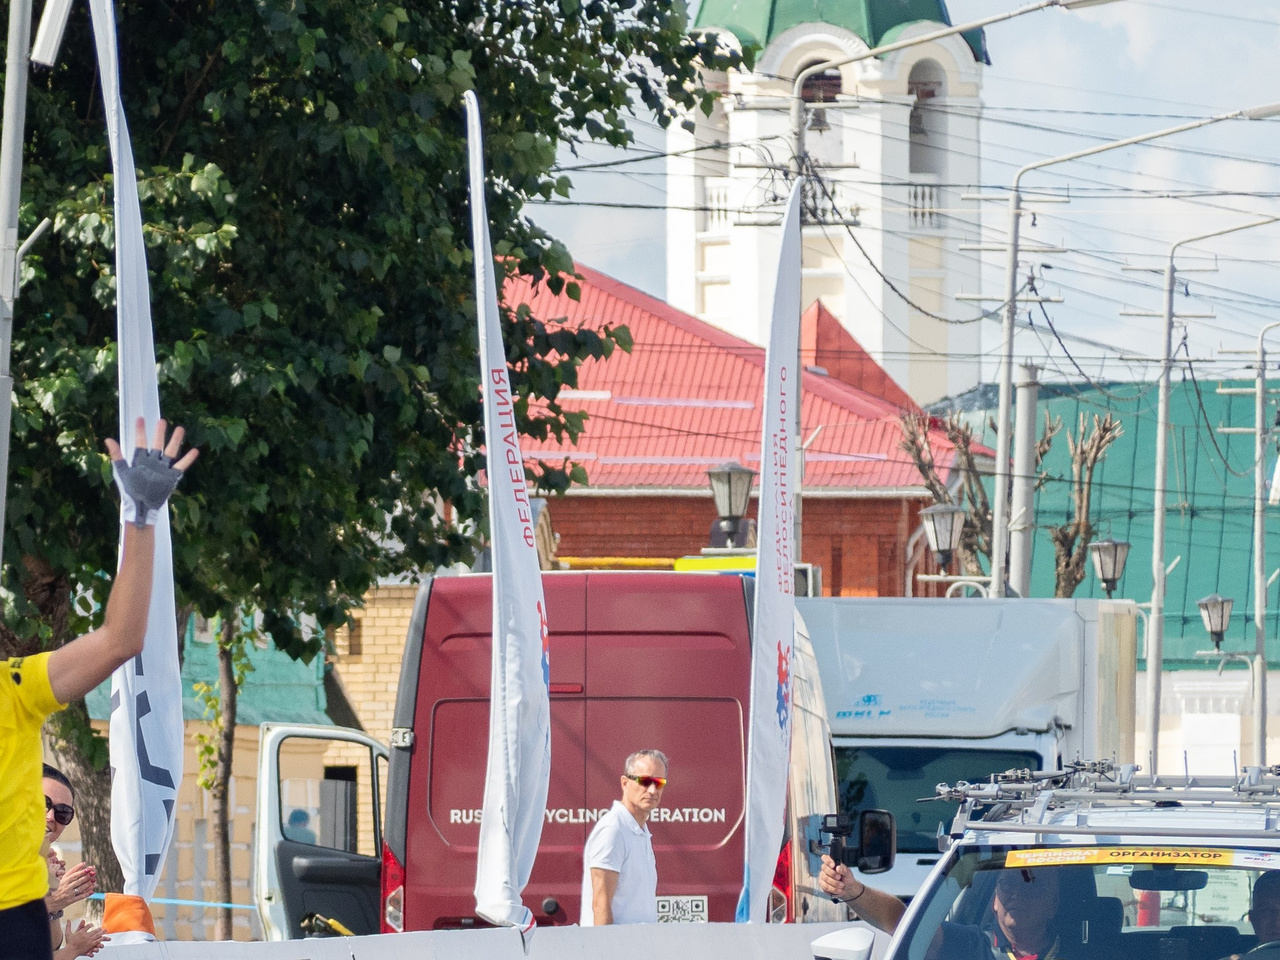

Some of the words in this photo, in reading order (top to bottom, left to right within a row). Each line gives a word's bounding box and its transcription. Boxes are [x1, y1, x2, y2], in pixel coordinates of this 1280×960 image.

[491, 368, 535, 548] ФЕДЕРАЦИЯ
[545, 808, 609, 823] YCLIN
[645, 808, 726, 822] ERATION
[1109, 851, 1223, 859] ОРГАНИЗАТОР
